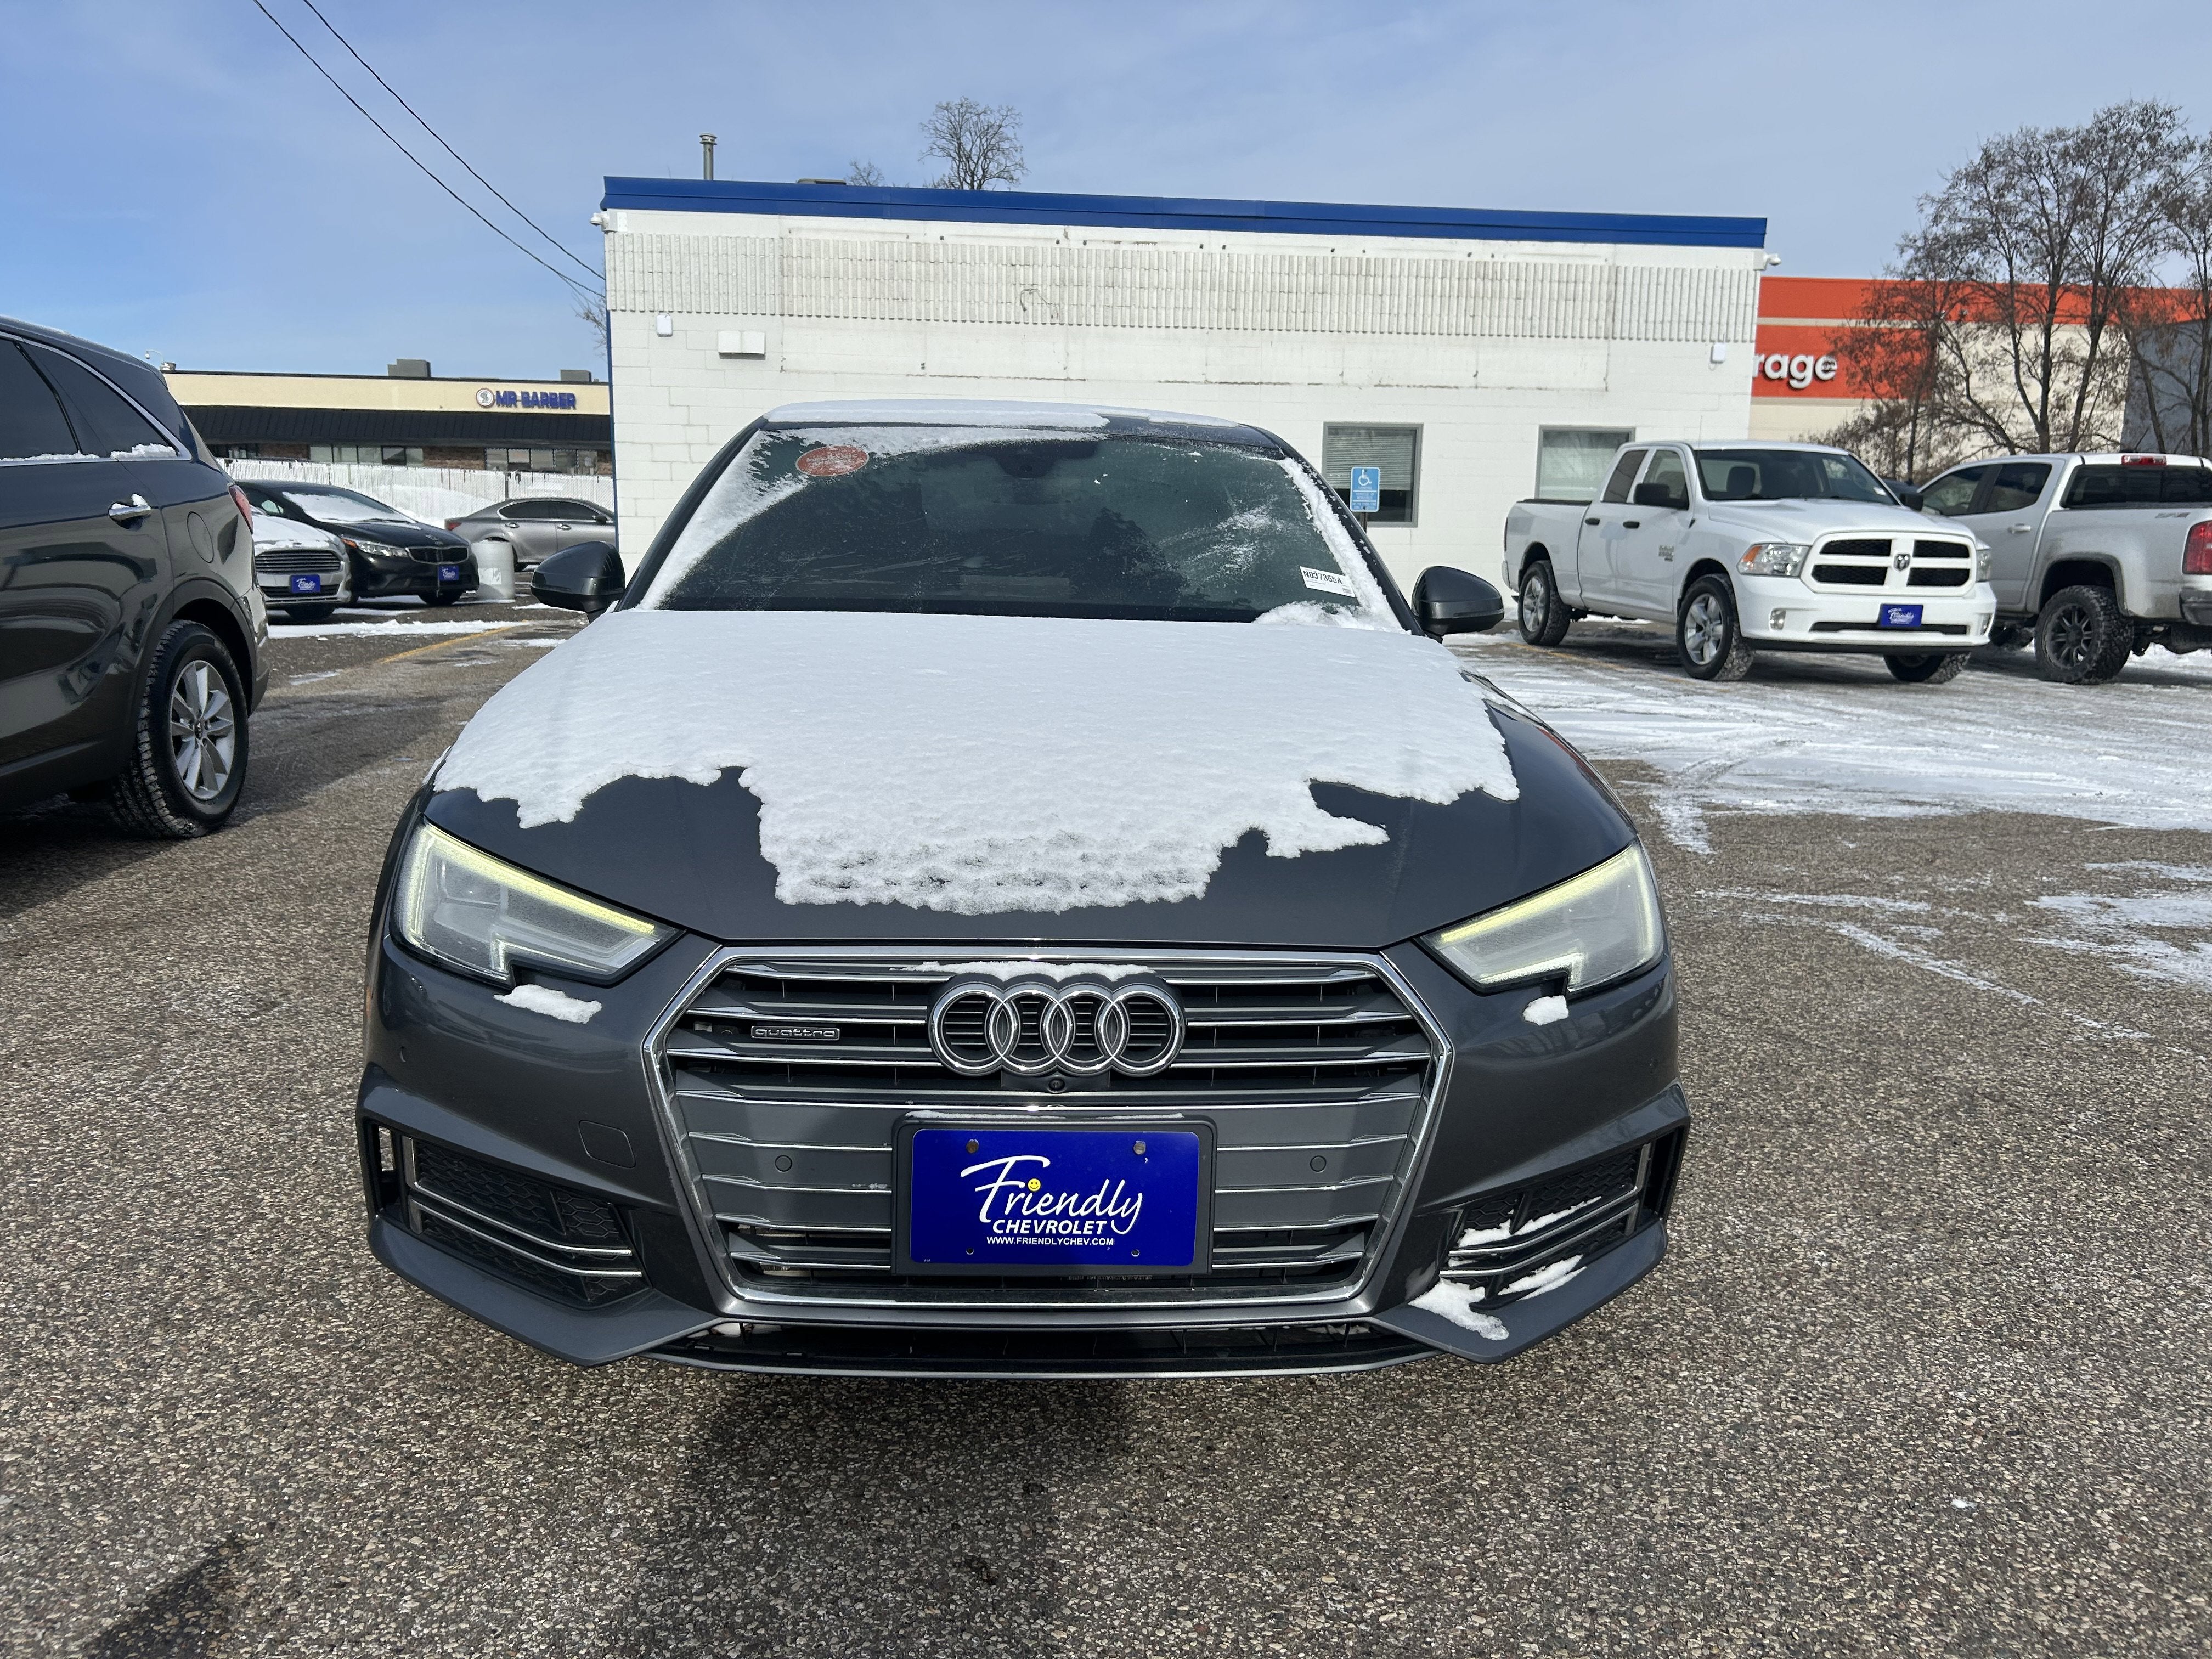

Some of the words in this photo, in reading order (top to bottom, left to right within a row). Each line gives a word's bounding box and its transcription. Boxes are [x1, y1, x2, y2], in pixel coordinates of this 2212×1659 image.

[1753, 353, 1837, 389] rage
[496, 391, 517, 408] MR
[521, 391, 576, 409] BARBER
[1303, 570, 1342, 585] N037365A
[755, 1029, 835, 1037] quattro
[961, 1155, 1142, 1234] Friendly
[992, 1219, 1107, 1234] CHEVROLET
[986, 1237, 1114, 1246] WWW.FRIENDLYCHEV.COM
